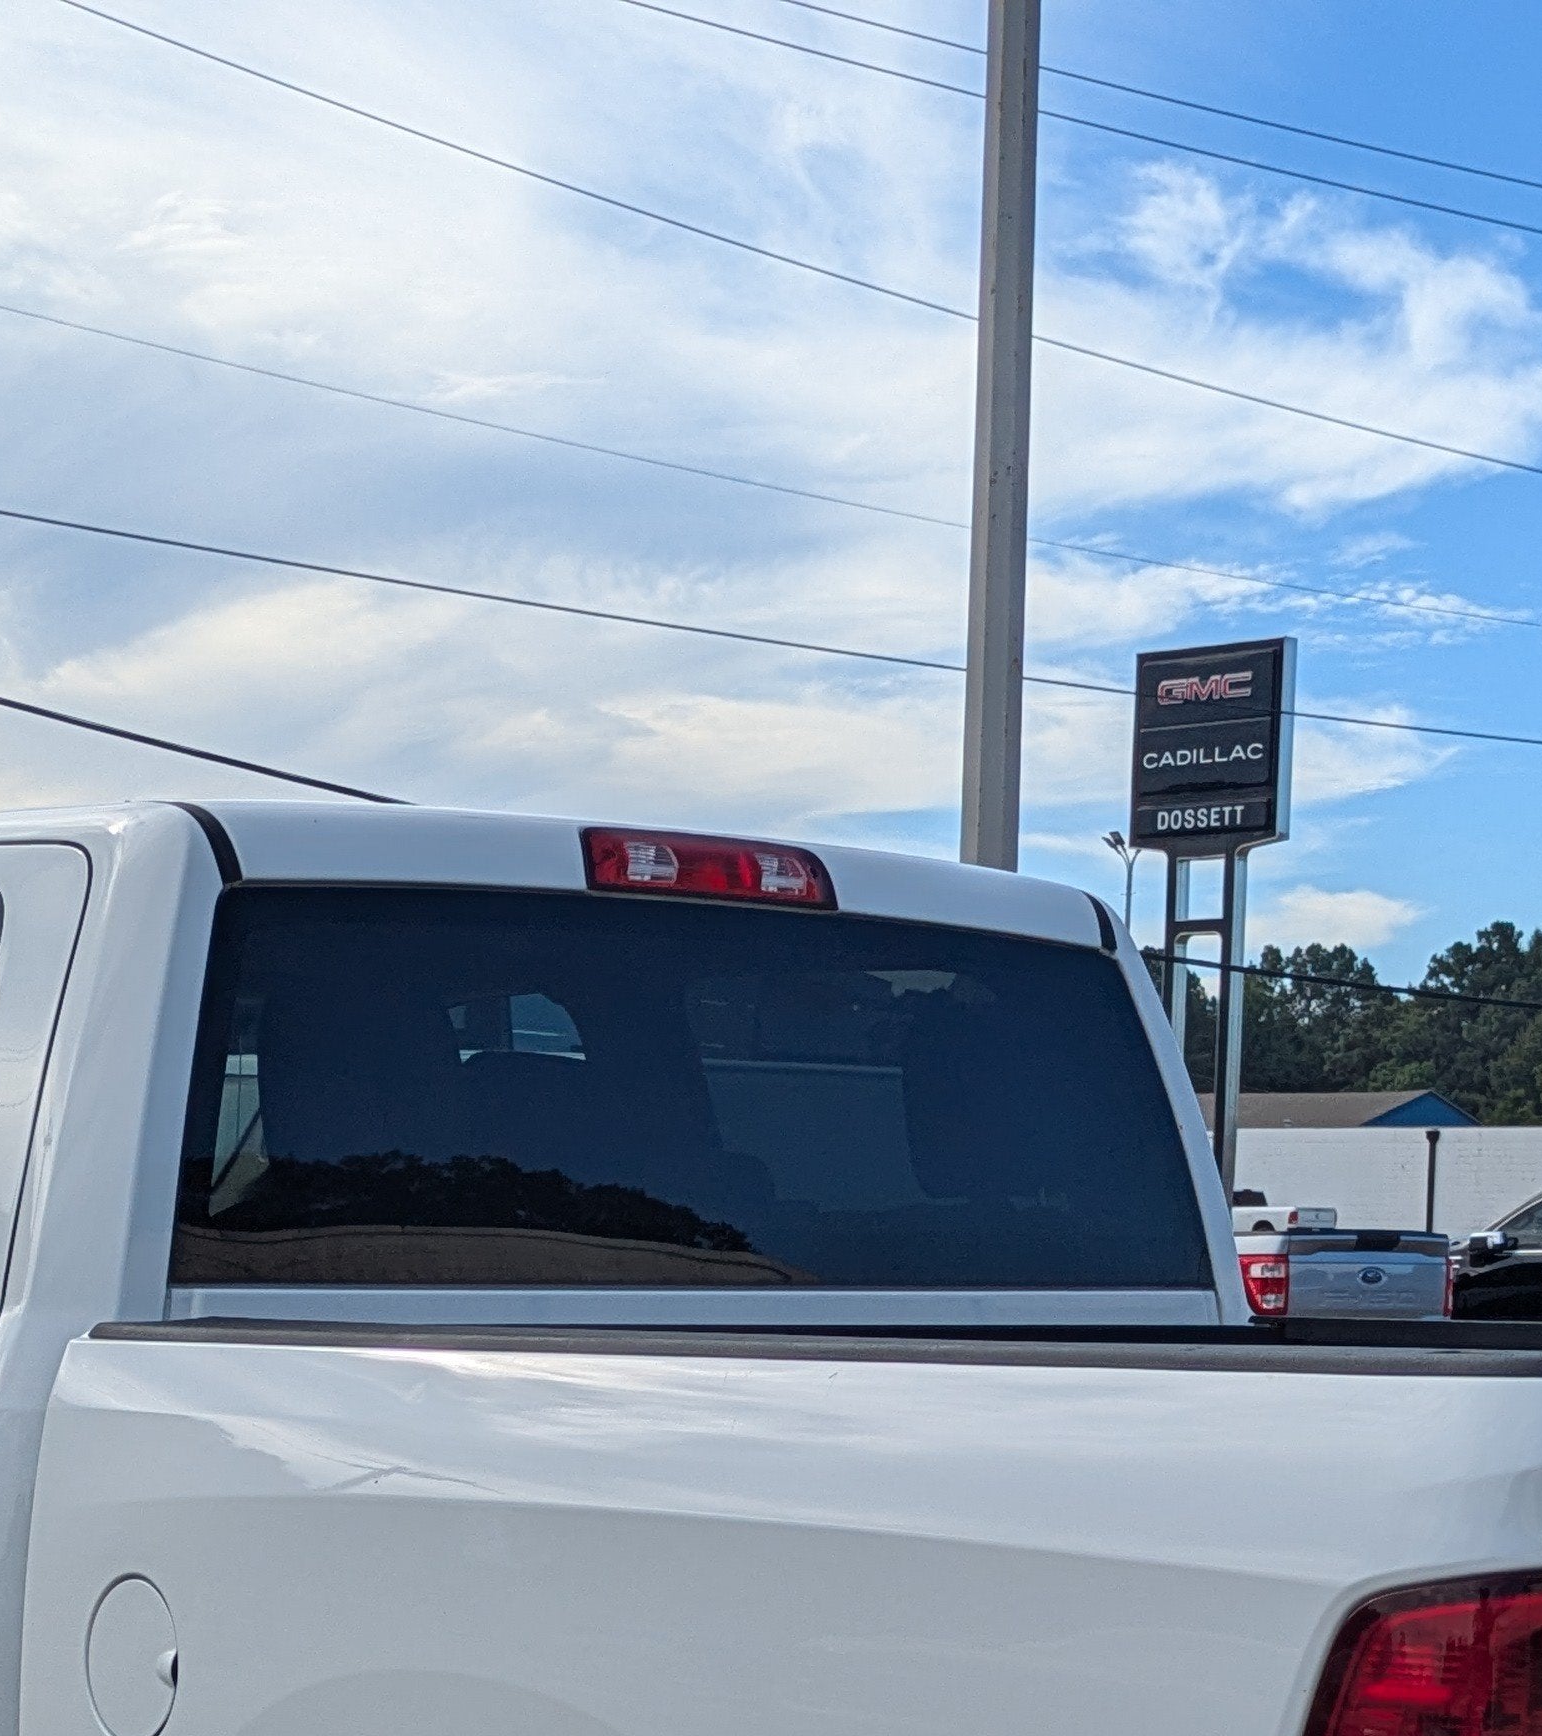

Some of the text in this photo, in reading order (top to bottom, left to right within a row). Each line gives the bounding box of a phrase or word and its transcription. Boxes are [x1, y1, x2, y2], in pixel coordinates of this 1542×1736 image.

[1157, 670, 1253, 705] GMC
[1142, 743, 1264, 769] CADILLAC
[1156, 805, 1245, 831] DOSSETT
